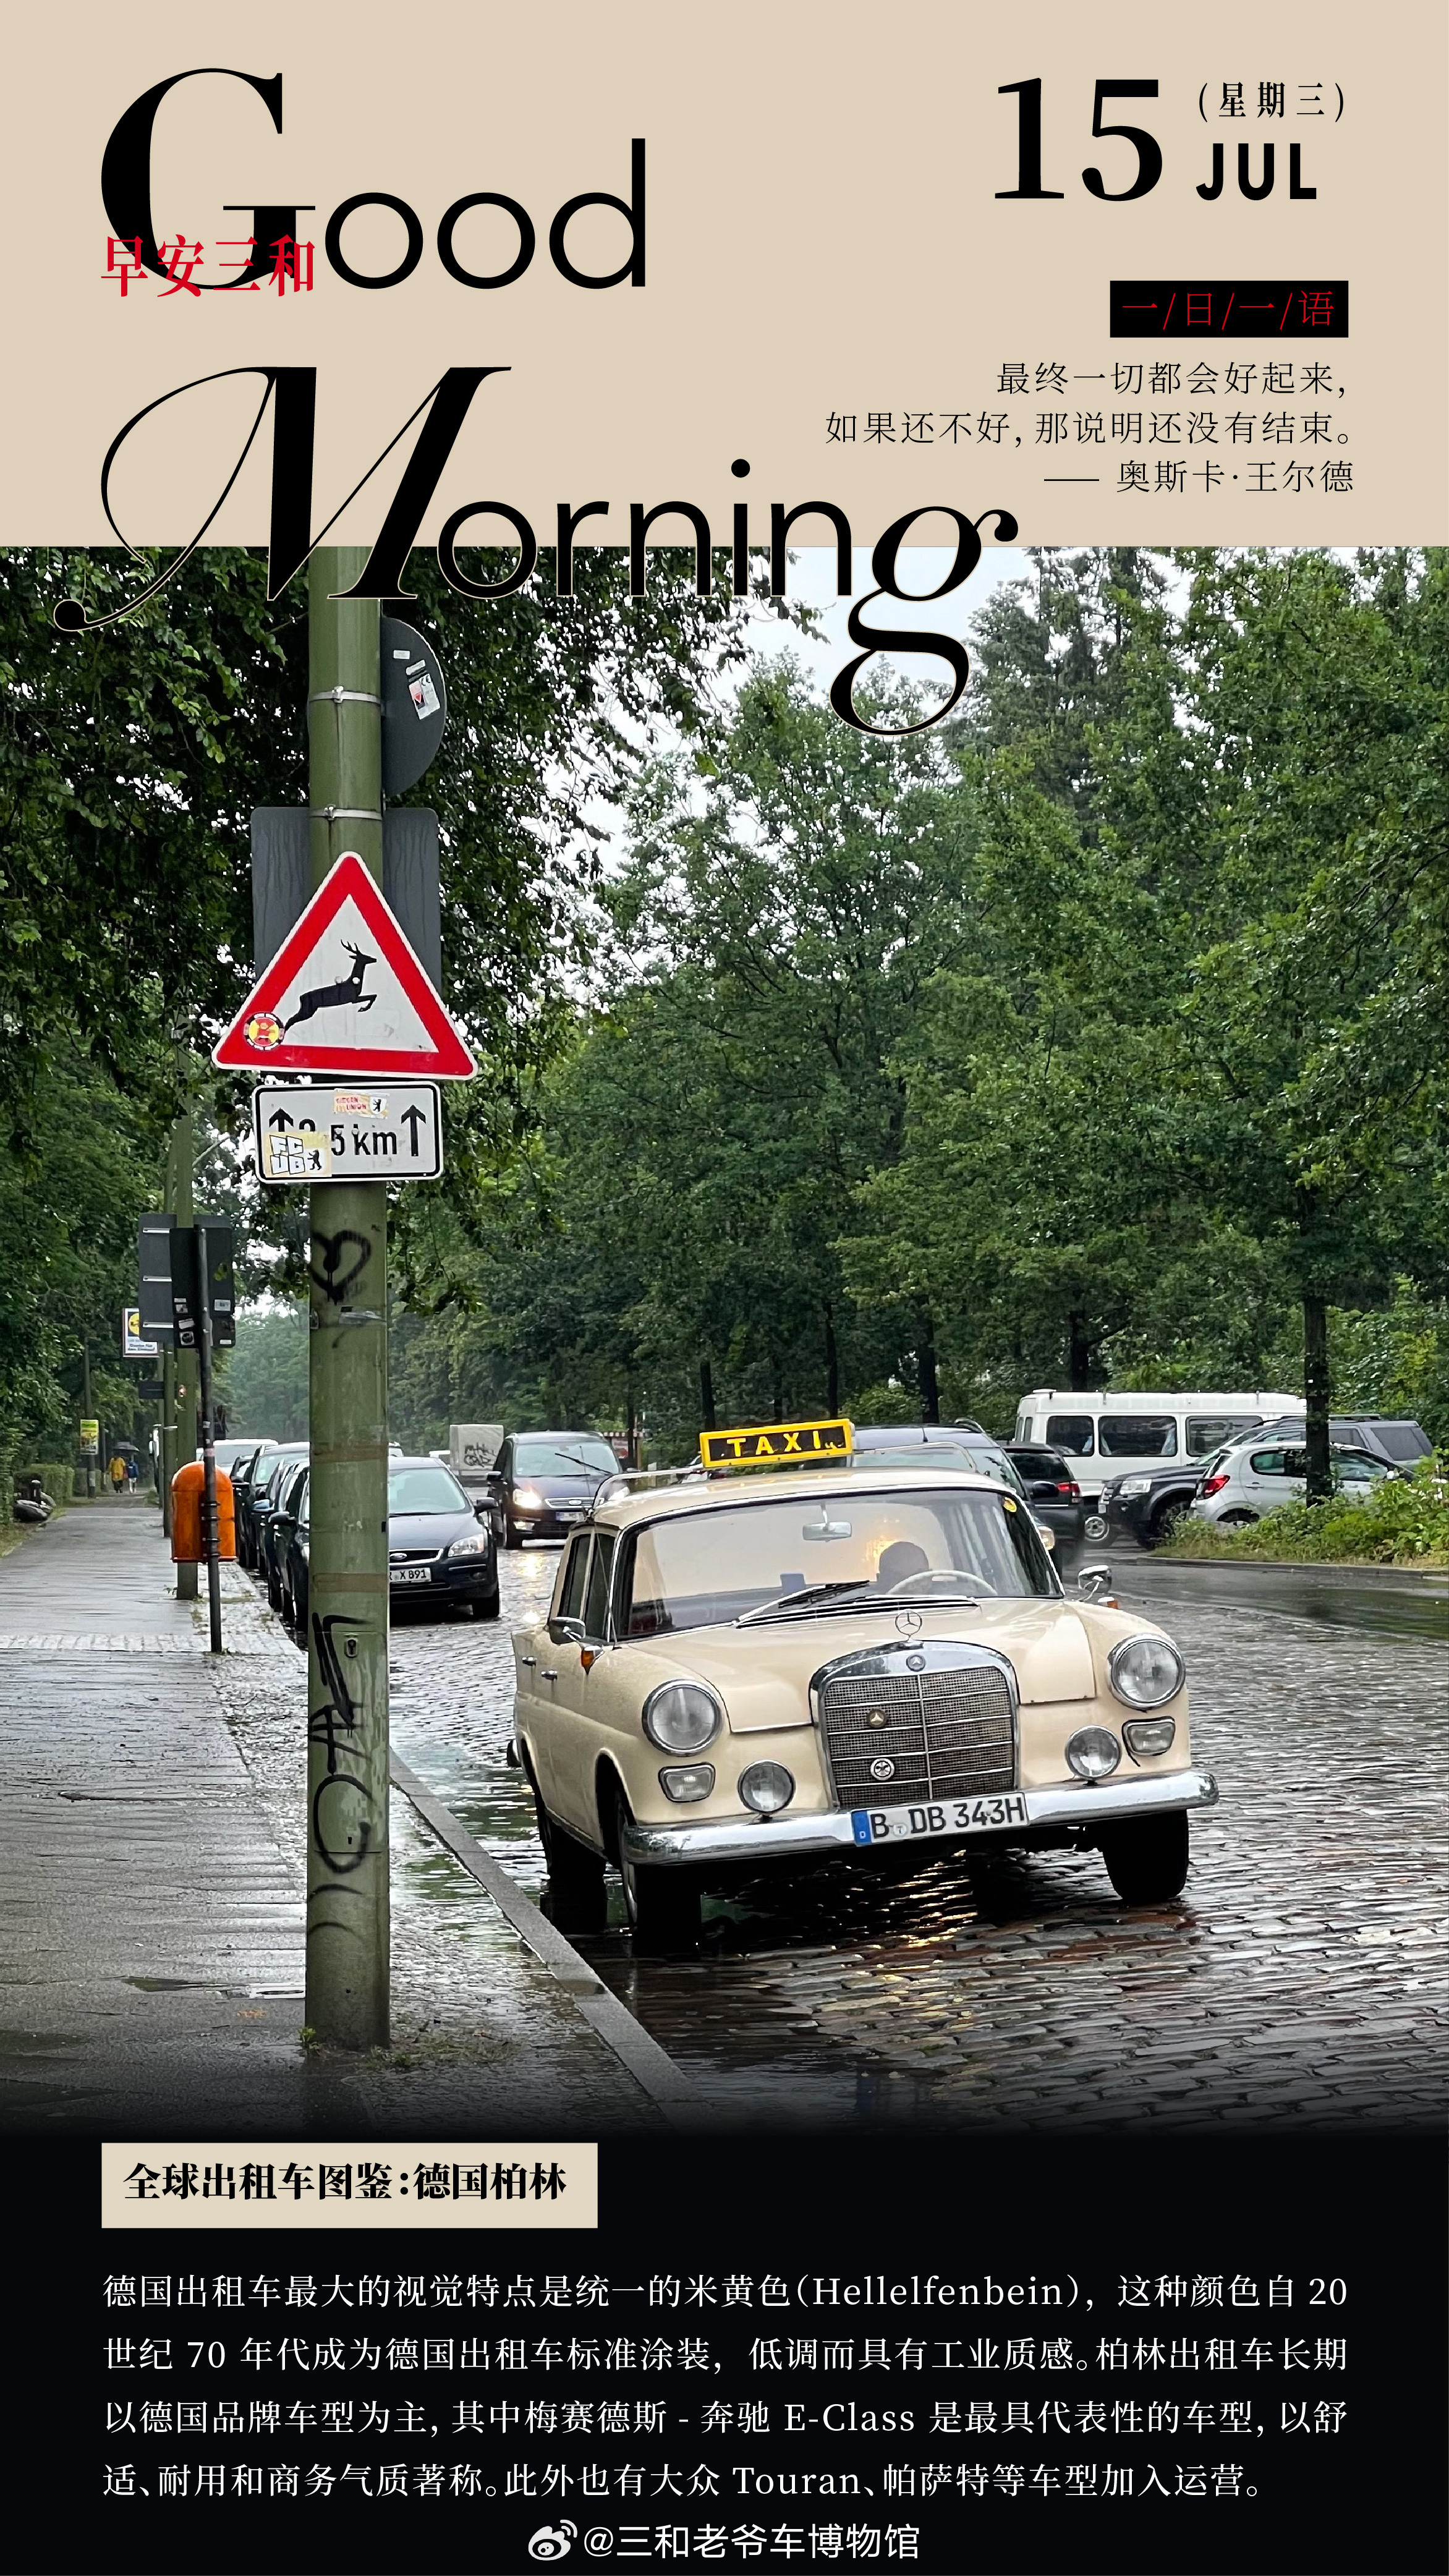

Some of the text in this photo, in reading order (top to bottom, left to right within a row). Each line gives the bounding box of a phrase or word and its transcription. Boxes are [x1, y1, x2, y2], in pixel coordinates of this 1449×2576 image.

[353, 1124, 397, 1155] km
[726, 1430, 821, 1457] TAXI
[399, 1571, 406, 1580] X
[409, 1569, 427, 1579] 891
[870, 1797, 1025, 1838] B DB 343H
